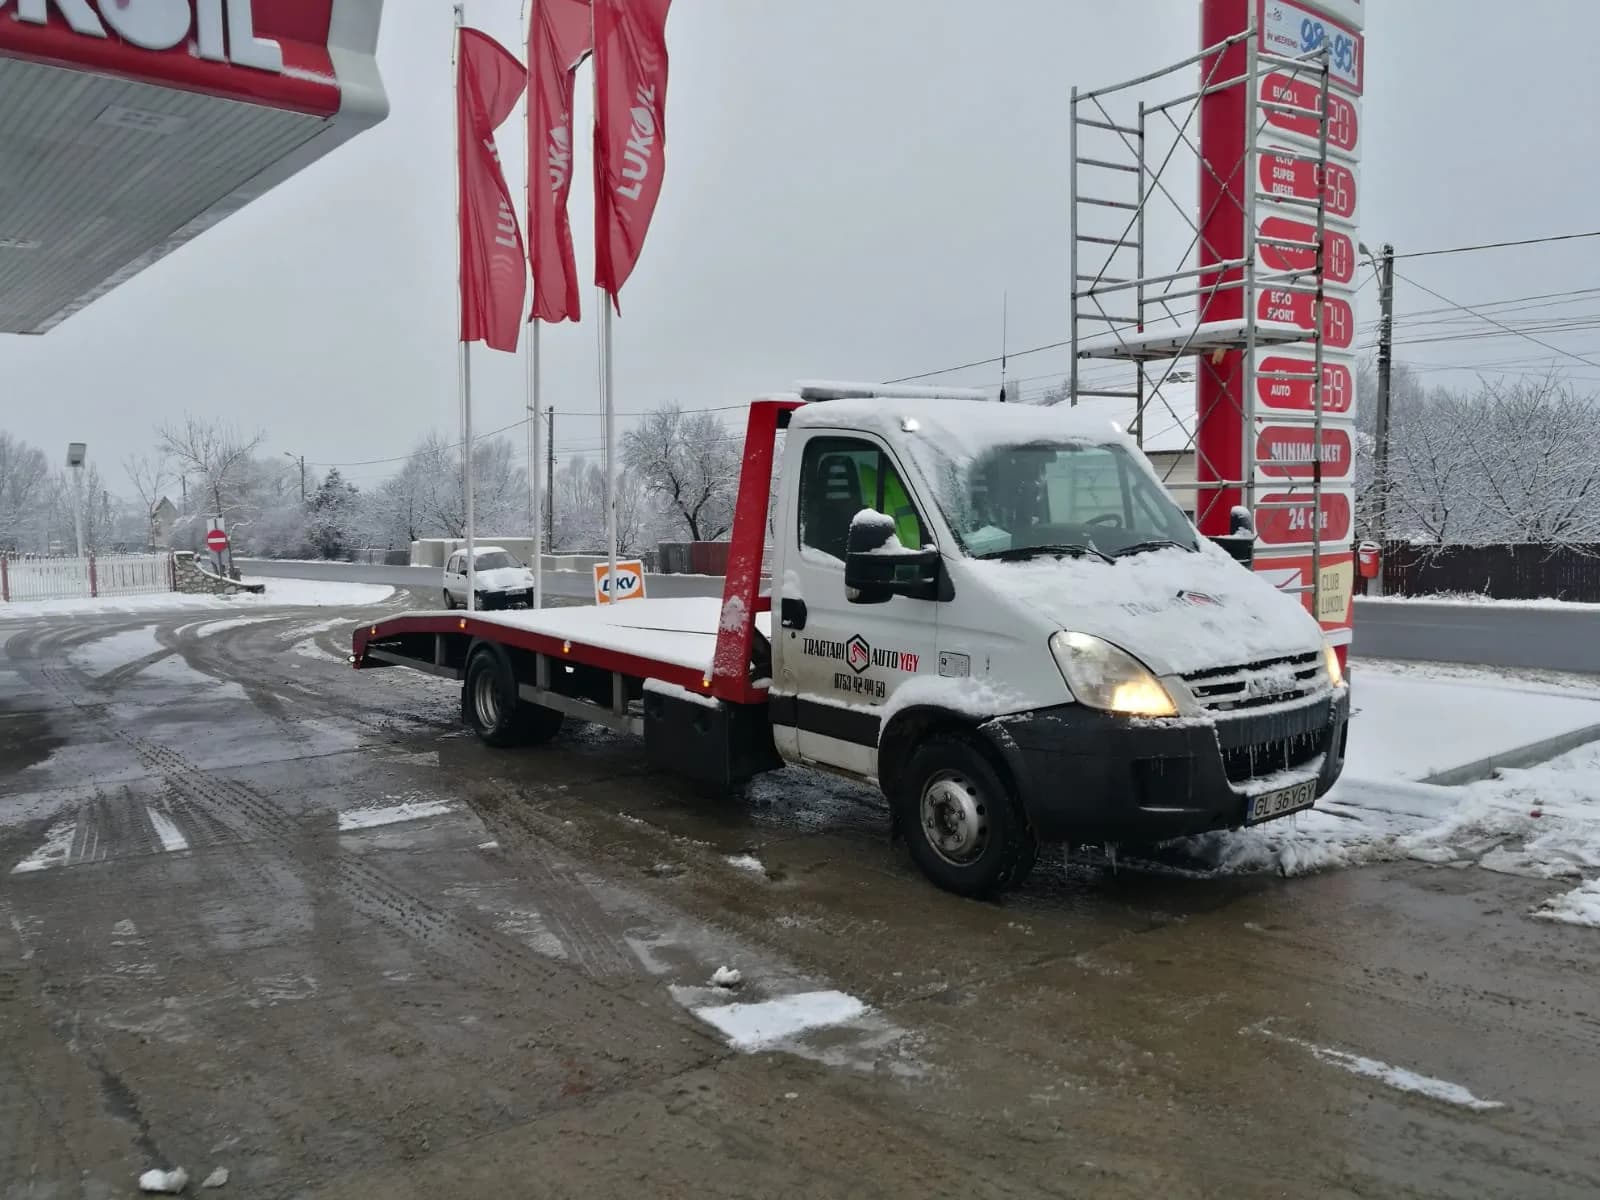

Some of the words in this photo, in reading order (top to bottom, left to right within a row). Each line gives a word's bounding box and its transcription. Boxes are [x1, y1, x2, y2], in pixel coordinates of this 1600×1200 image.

[1272, 166, 1295, 182] SUPER
[1270, 384, 1291, 397] AUTO
[1288, 507, 1305, 530] 24
[1322, 573, 1340, 591] CLUB
[802, 638, 845, 661] TRACTARI
[1254, 798, 1271, 816] GL
